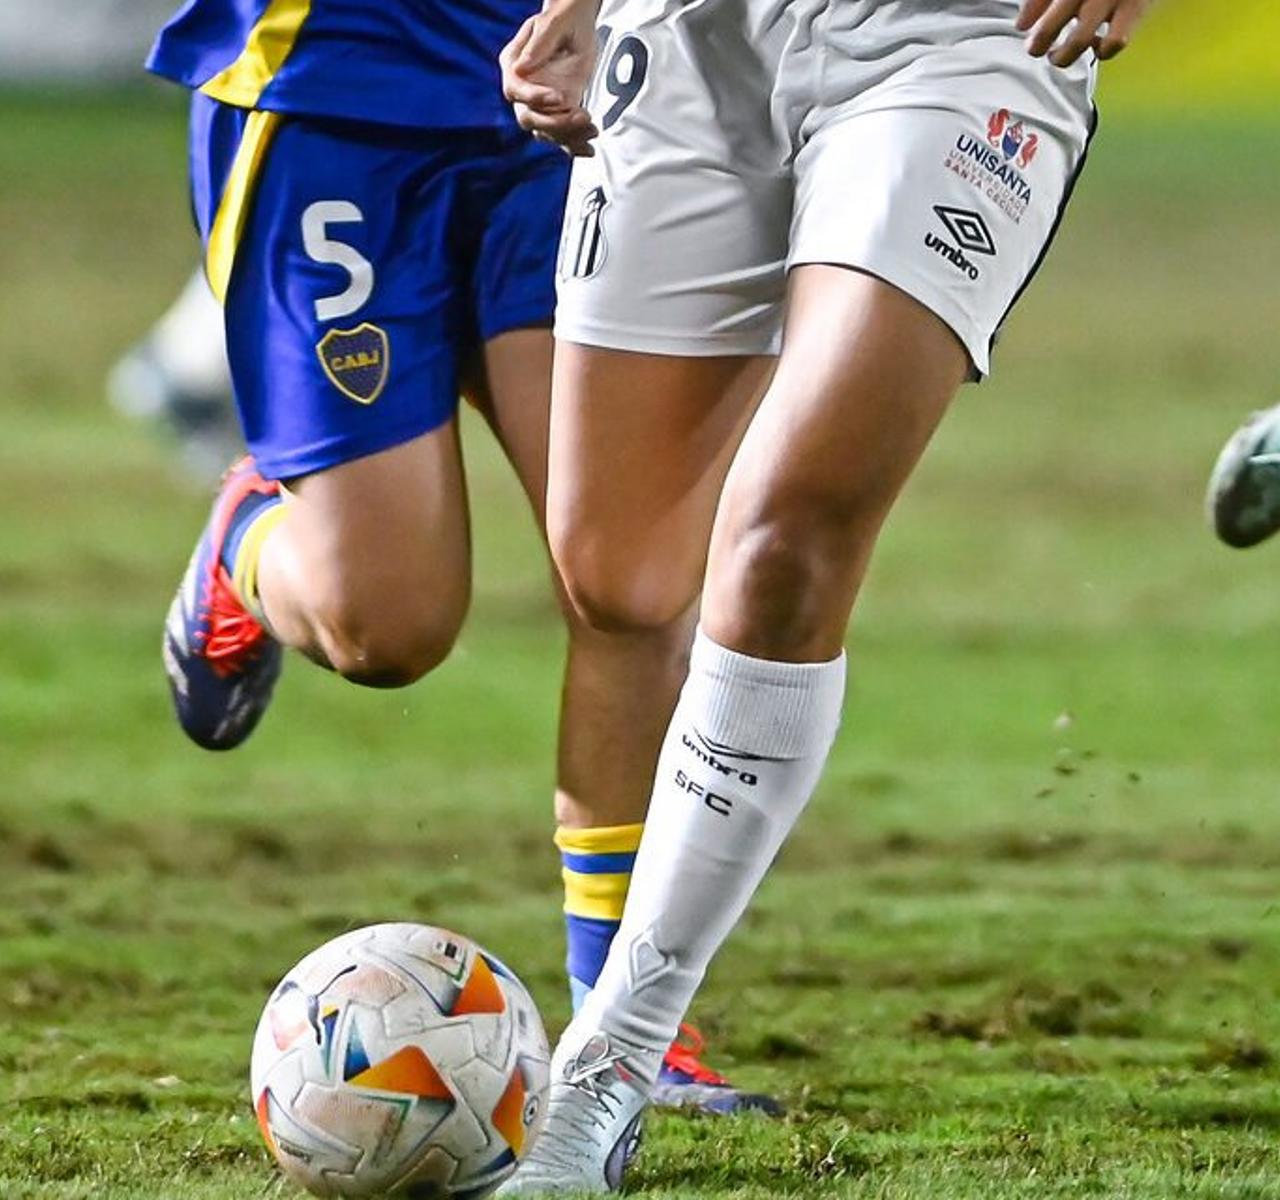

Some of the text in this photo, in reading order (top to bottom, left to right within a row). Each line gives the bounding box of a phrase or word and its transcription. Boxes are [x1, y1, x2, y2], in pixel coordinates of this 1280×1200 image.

[944, 158, 983, 188] SANTA
[956, 134, 1032, 204] UNISANTA
[300, 200, 374, 322] 5
[924, 231, 980, 280] umbro
[682, 734, 758, 786] umbro
[675, 769, 732, 817] SFC
